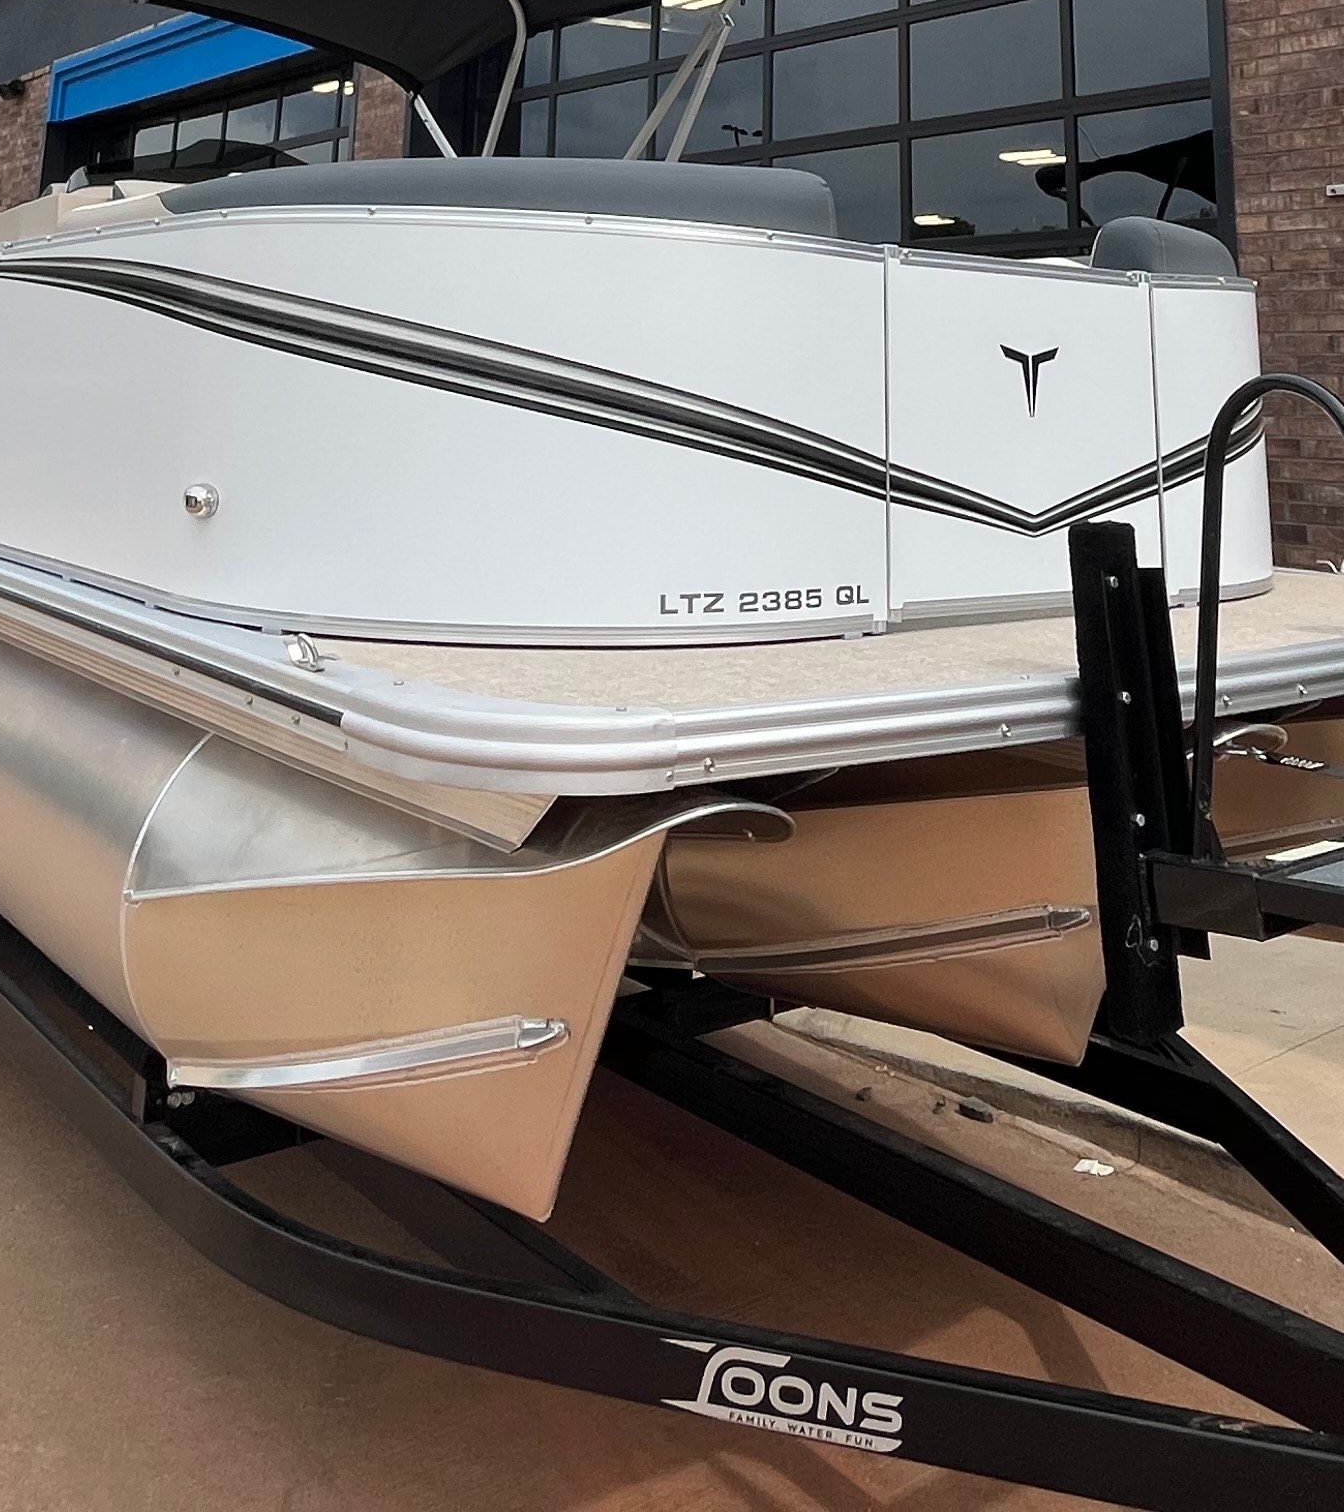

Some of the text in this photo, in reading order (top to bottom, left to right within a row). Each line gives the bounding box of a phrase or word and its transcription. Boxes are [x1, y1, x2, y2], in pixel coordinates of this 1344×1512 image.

[659, 584, 870, 615] LTZ 2385 QL
[659, 1338, 904, 1433] TOONS
